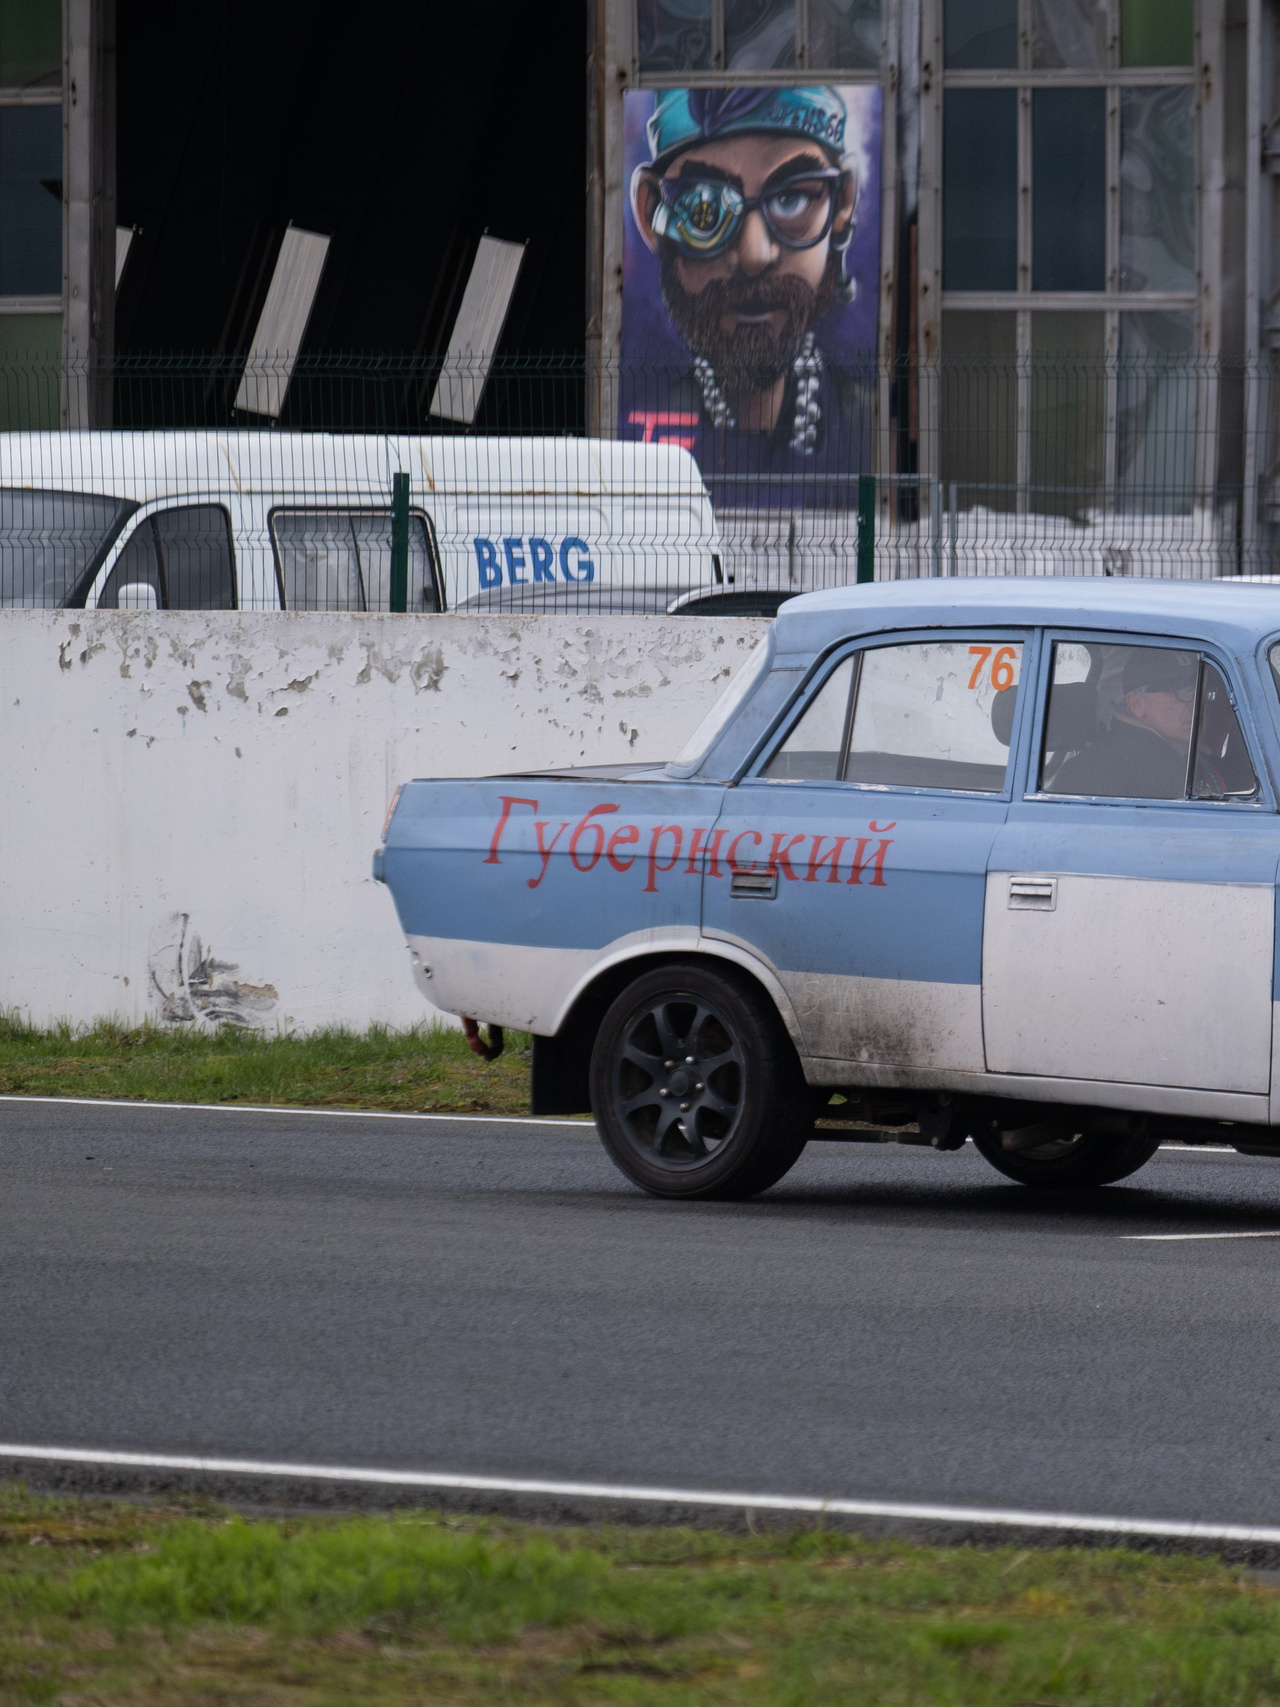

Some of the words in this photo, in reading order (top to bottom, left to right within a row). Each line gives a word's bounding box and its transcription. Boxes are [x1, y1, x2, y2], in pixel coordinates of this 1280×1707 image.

[473, 537, 594, 589] BERG
[967, 646, 1017, 692] 76
[481, 796, 897, 893] Губернский
